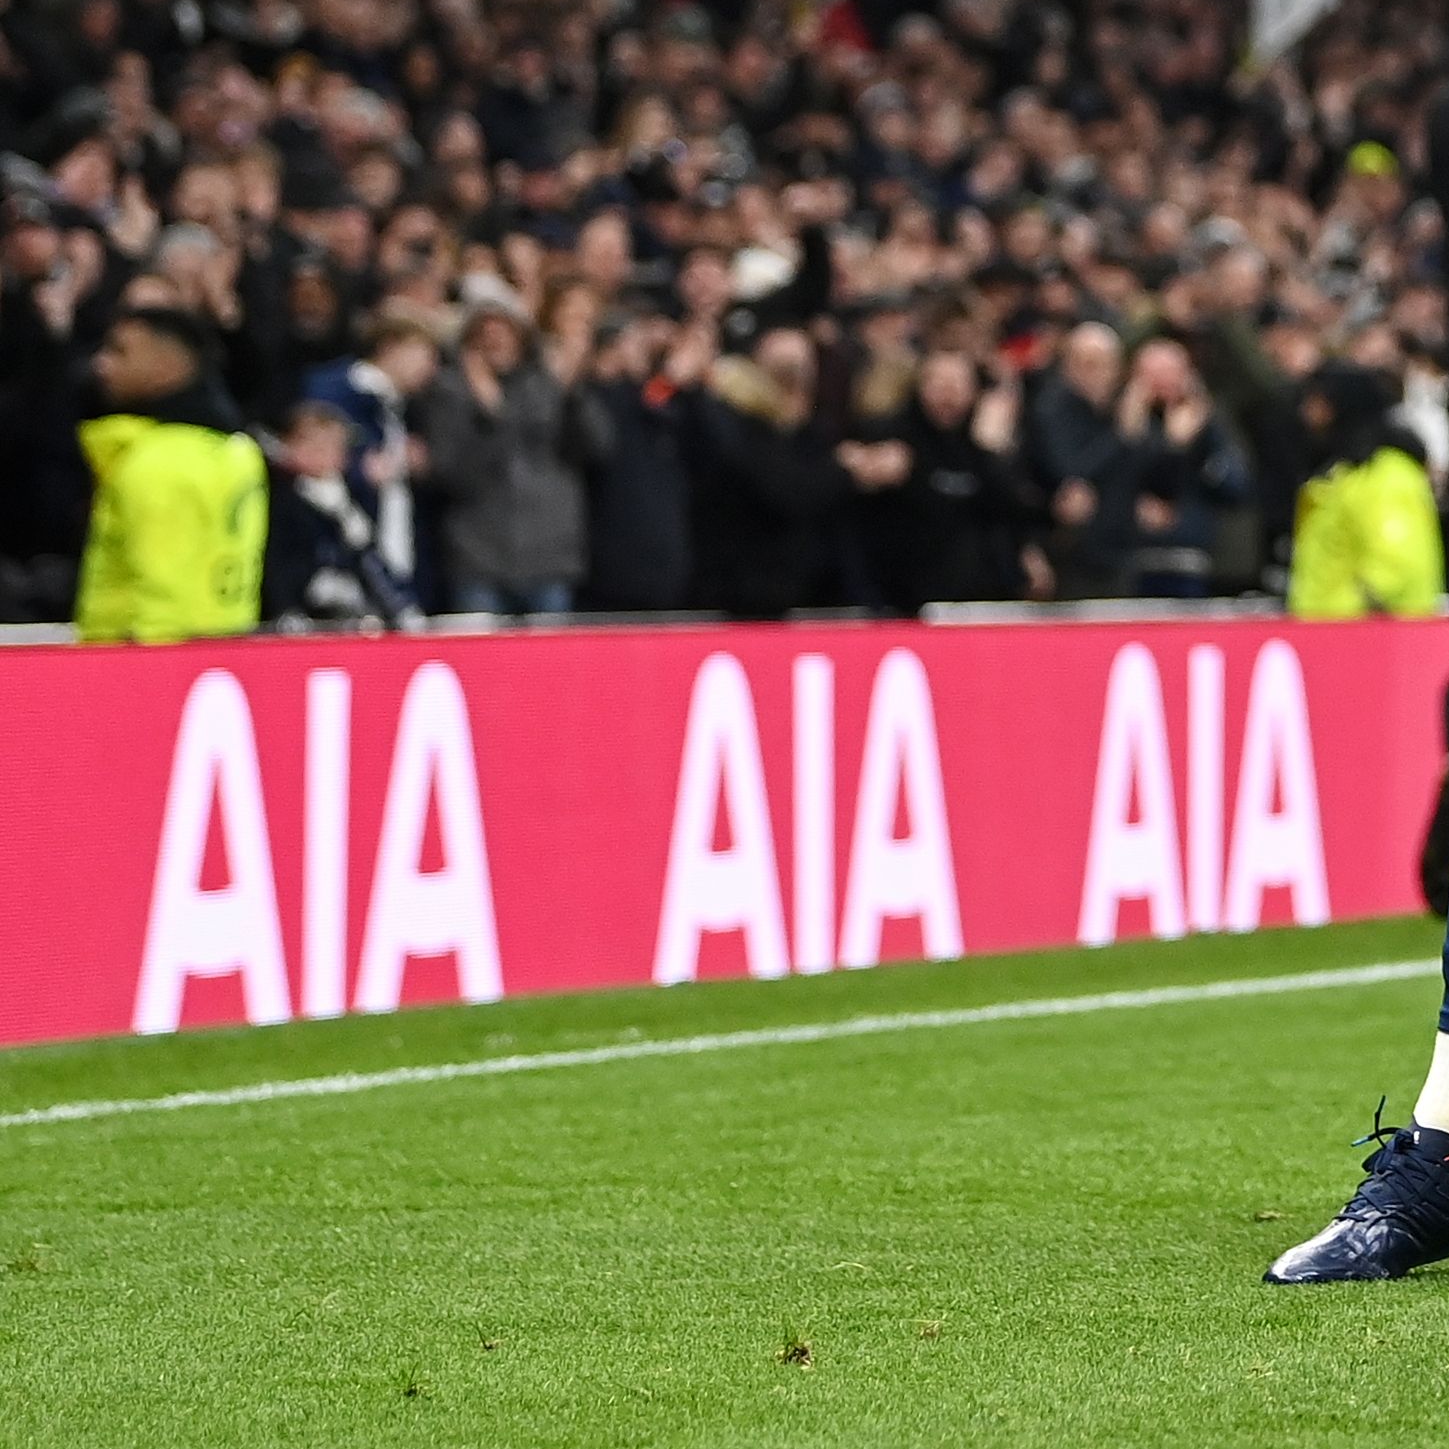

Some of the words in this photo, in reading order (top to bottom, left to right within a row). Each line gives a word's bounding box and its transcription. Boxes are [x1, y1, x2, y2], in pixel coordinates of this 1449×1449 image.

[132, 660, 504, 1035] AIA
[652, 647, 964, 987] AIA
[1077, 637, 1332, 947] AIA
